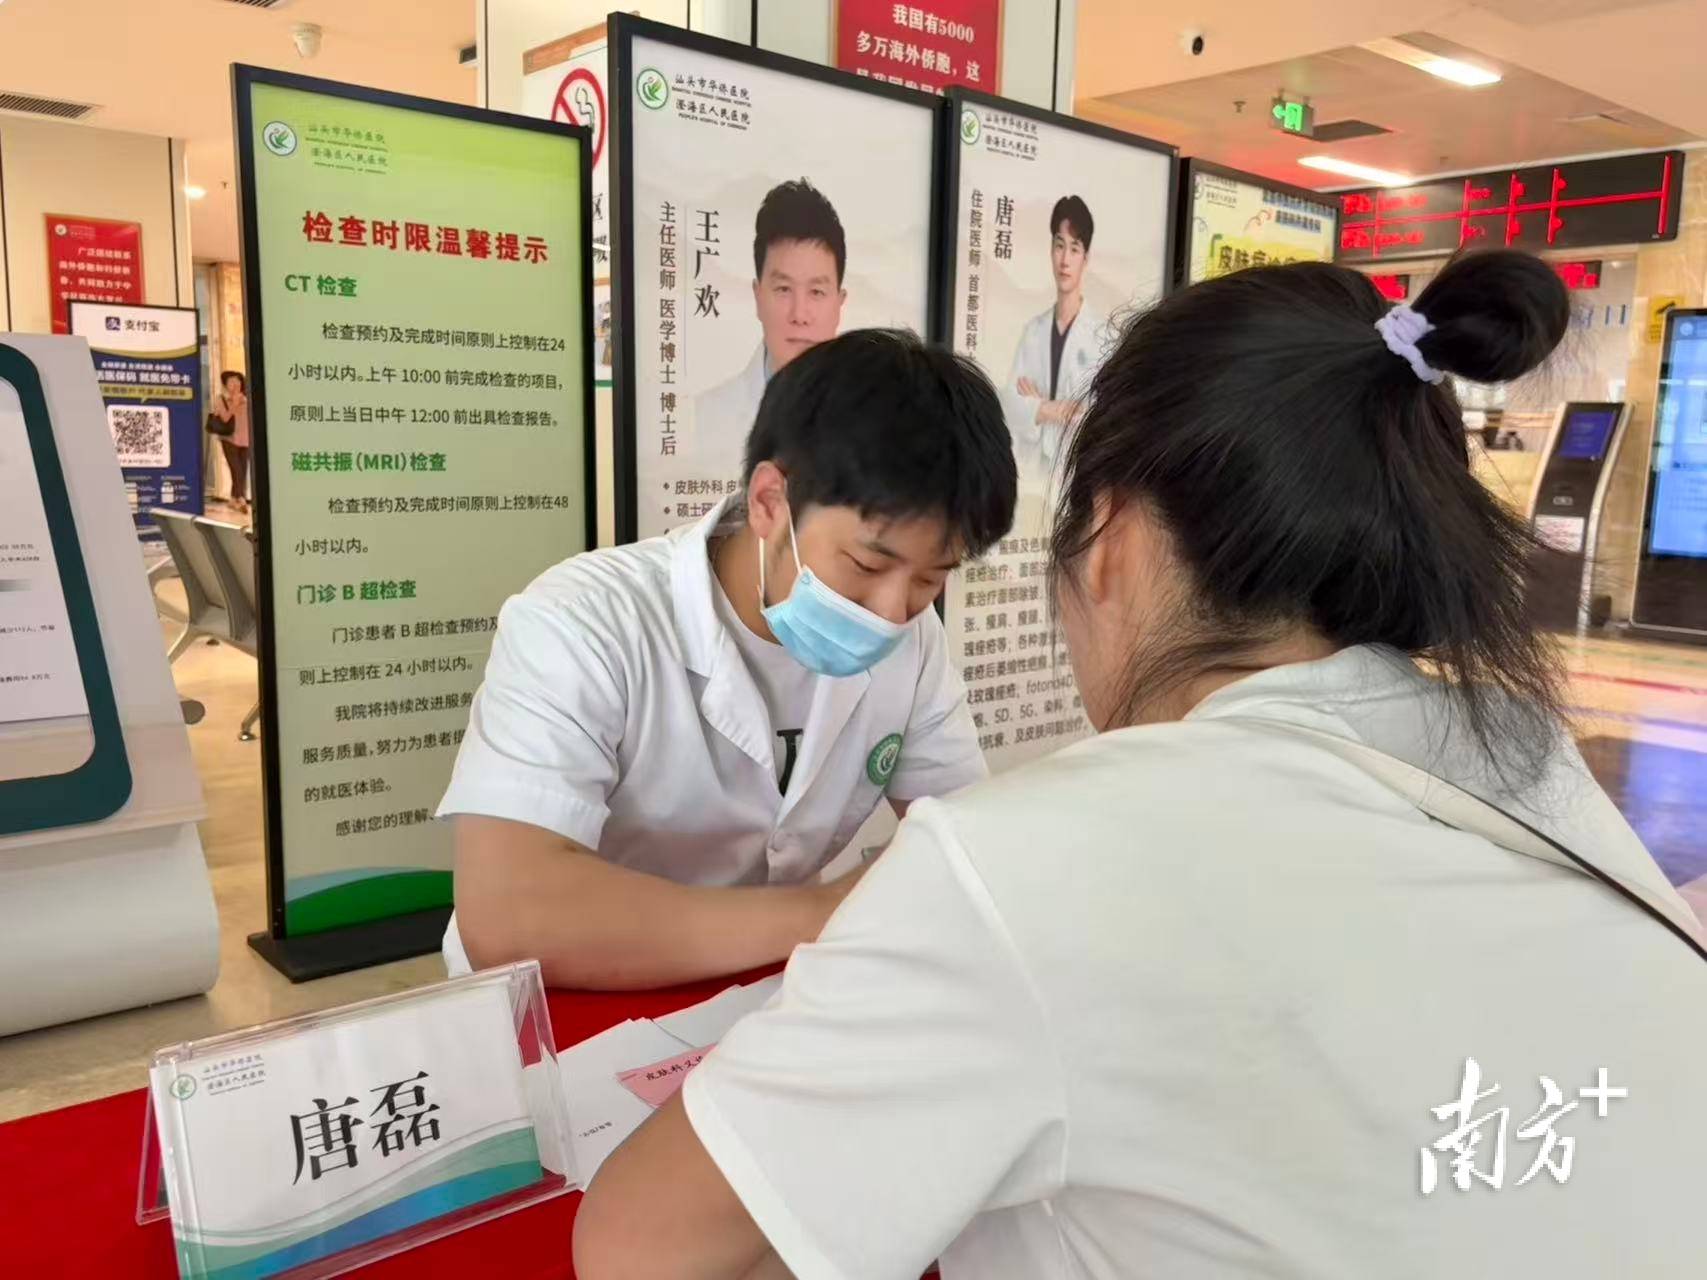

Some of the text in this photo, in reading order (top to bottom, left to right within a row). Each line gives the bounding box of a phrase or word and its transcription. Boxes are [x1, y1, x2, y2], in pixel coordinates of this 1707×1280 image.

[892, 3, 975, 43] 我国有5000
[856, 30, 980, 82] 多万海外侨胞，这
[675, 73, 750, 101] 汕头市华侨医院
[302, 210, 549, 264] 检查时限温馨提示
[968, 189, 984, 267] 住院医师
[994, 195, 1014, 260] 唐磊
[694, 209, 720, 318] 王广欢
[285, 274, 357, 298] CT 检查
[125, 320, 160, 332] 支付宝
[322, 322, 566, 352] 检查预约及完成时间原则上控制在24
[659, 201, 676, 456] 主任医师 医学博士 博士后
[288, 363, 563, 390] 小时以内。上午 10:00 前完成检查的项目，
[290, 404, 558, 427] 原则上当日中午 12:00 前出具检查报告。
[675, 480, 723, 495] 皮肤外科
[328, 495, 569, 515] 检查预约及完成时间原则上控制在48
[294, 539, 369, 555] 小时以内。
[297, 579, 417, 604] 门诊 B 超检查
[332, 615, 498, 644] 门诊患者 B 超检查预约及
[299, 656, 473, 687] 则上控制在 24 小时以内。
[335, 692, 472, 722] 我院将持续改进服务
[304, 777, 392, 803] 的就医体验。
[335, 808, 435, 836] 感谢您的理解、
[290, 1070, 442, 1186] 唐磊
